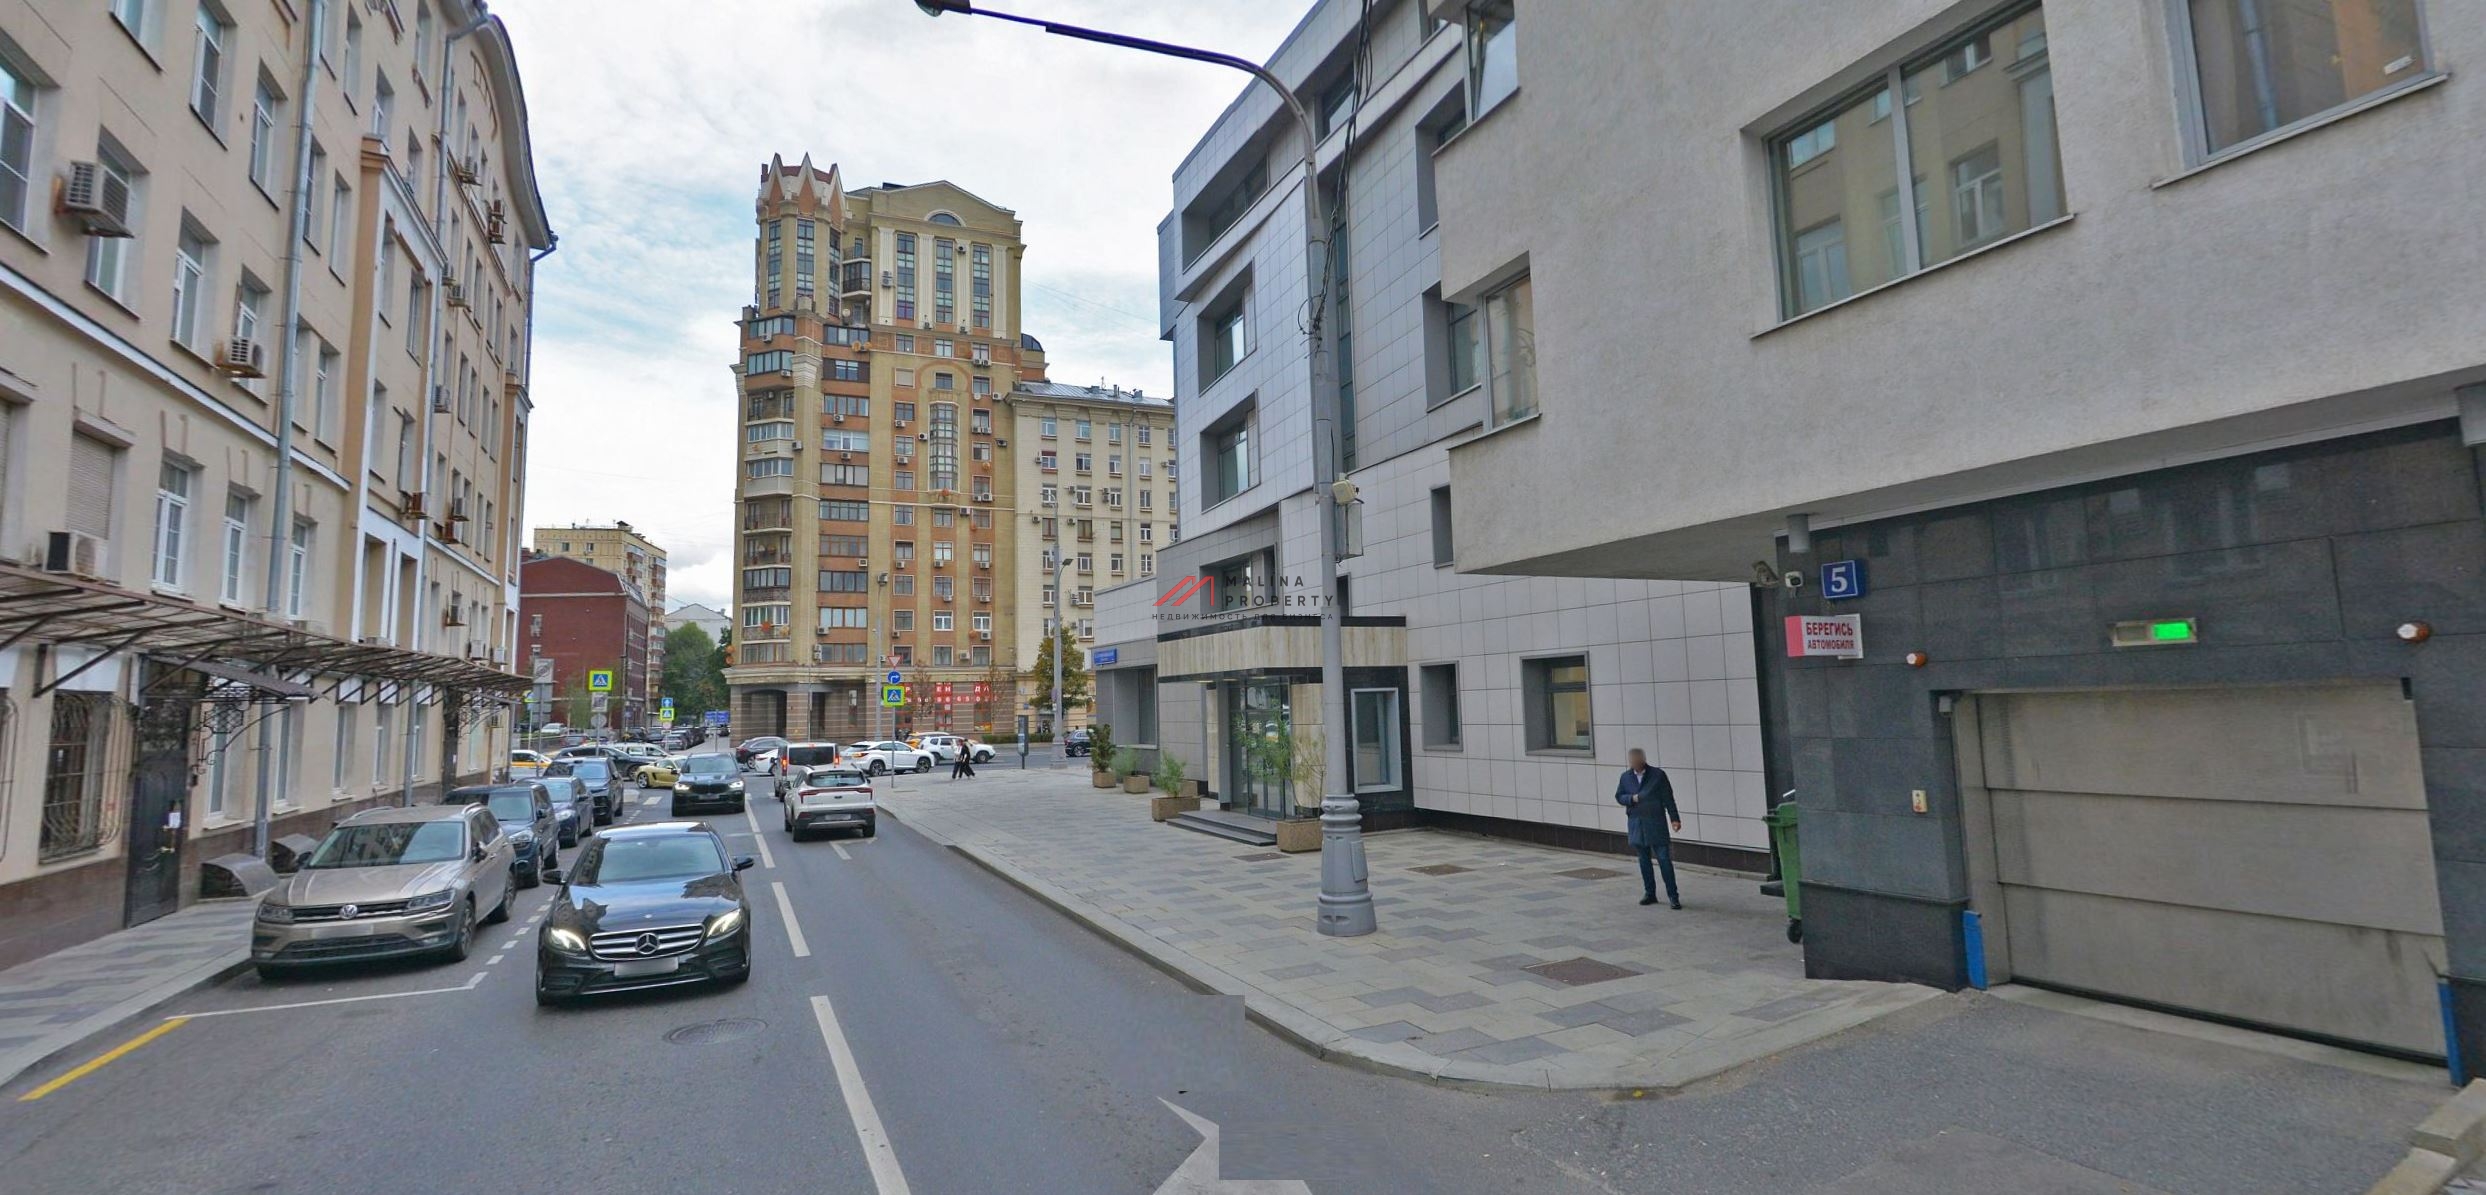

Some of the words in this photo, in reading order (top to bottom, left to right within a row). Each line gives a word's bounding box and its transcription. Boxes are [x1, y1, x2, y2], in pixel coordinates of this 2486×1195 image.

[1831, 566, 1848, 593] 5
[1806, 622, 1853, 636] БЕРЕГИСЬ
[1807, 639, 1854, 650] АВТОМОБИЛЯ
